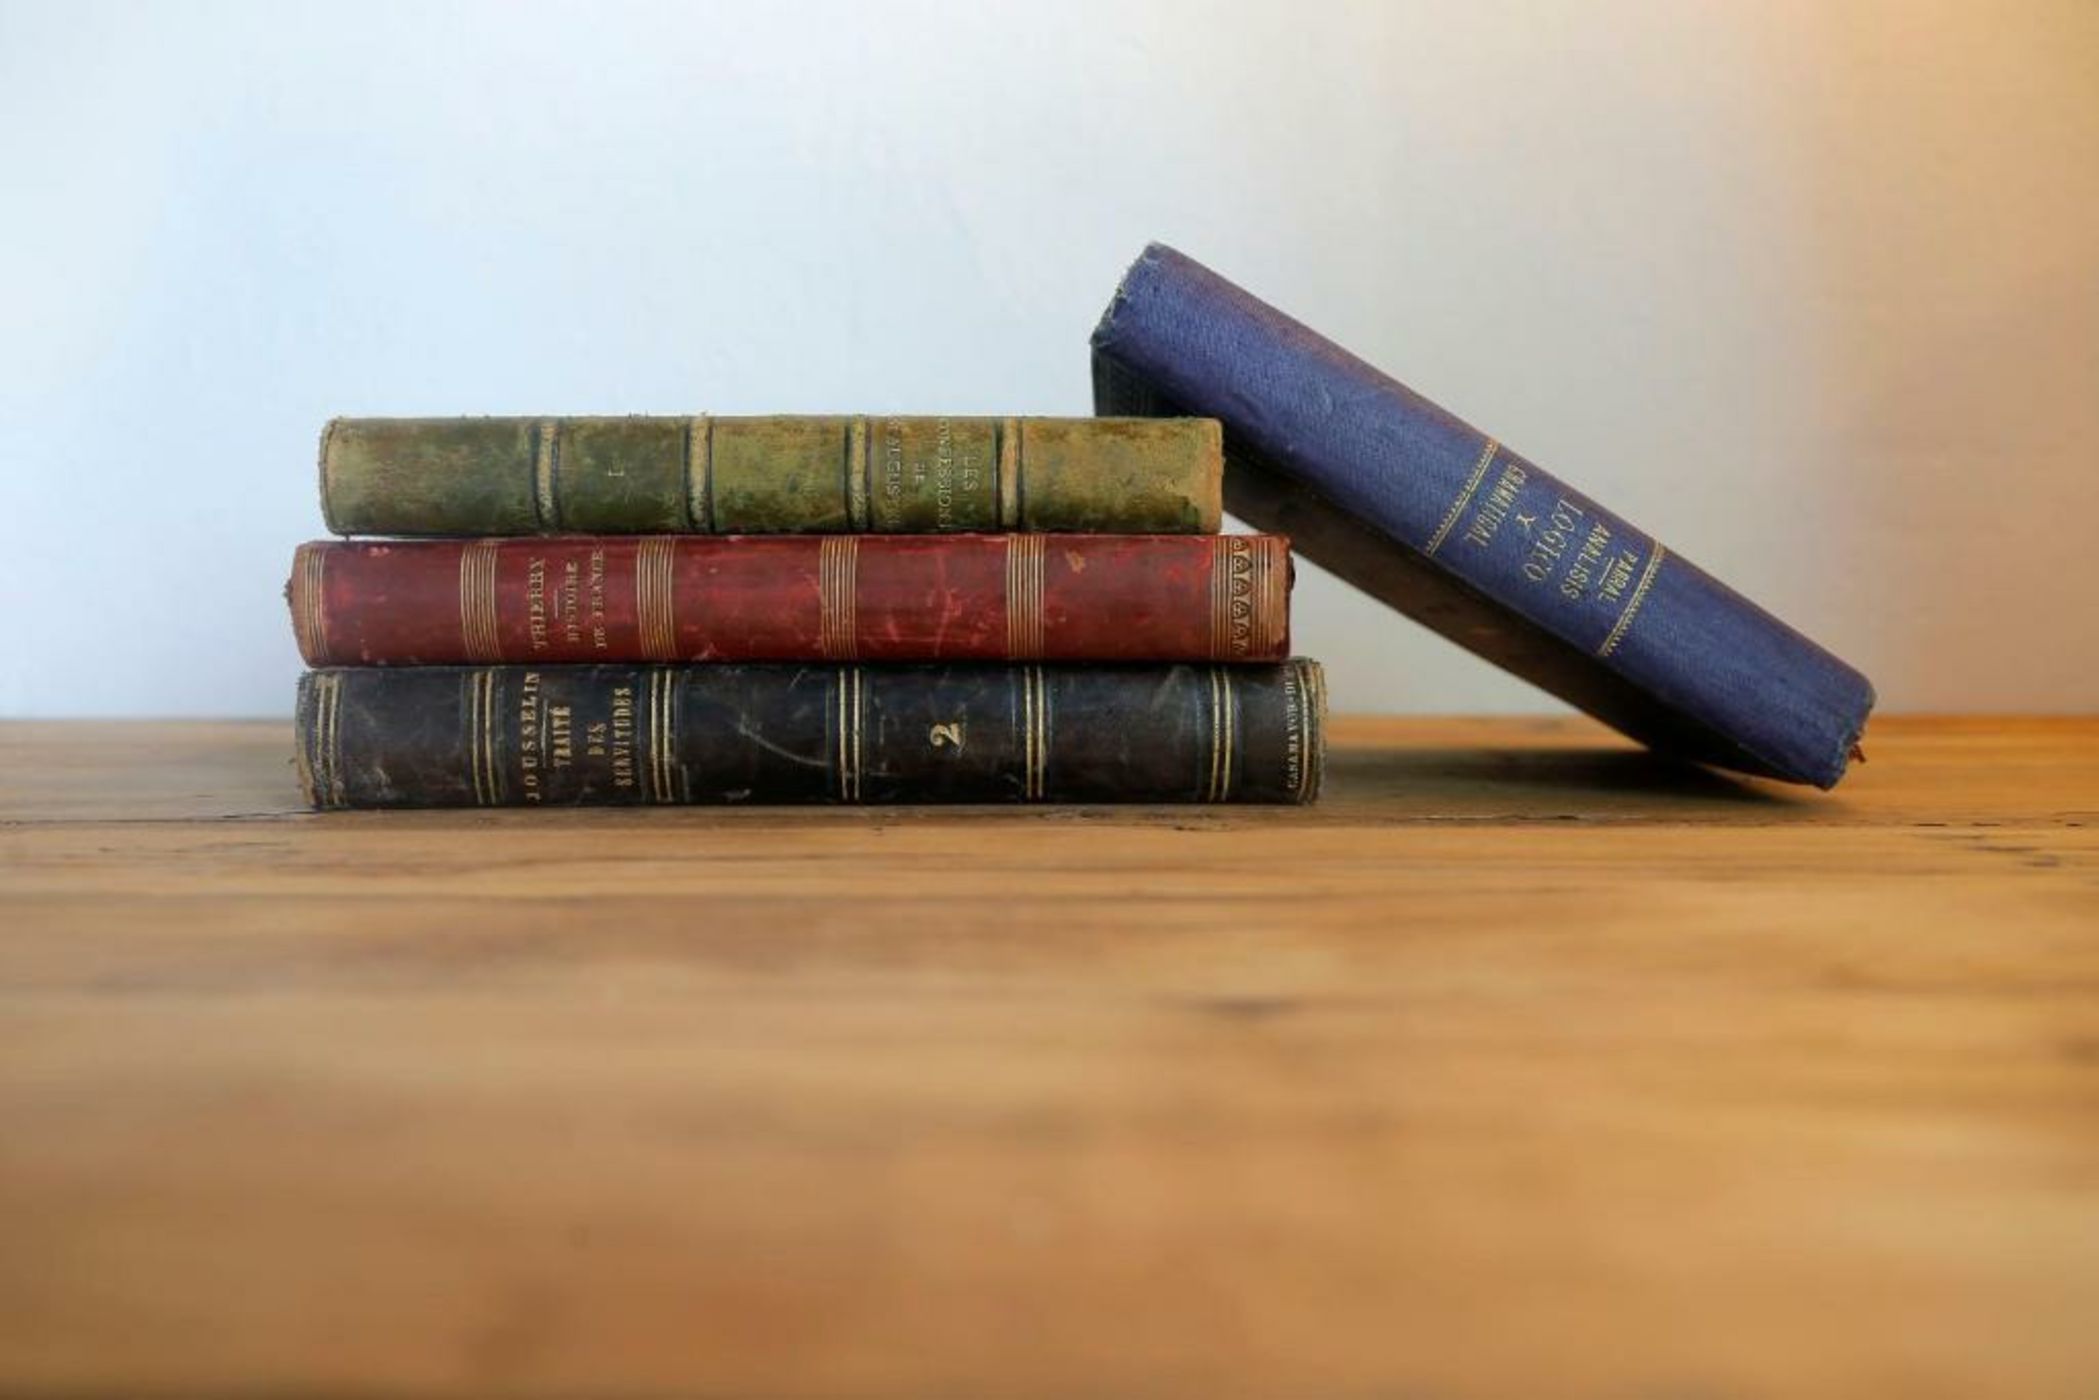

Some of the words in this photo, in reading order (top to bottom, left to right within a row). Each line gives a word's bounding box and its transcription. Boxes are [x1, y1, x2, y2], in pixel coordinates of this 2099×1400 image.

[962, 455, 980, 491] LES
[1463, 463, 1529, 548] GRAMATICAL
[1516, 513, 1537, 532] Y
[1522, 499, 1584, 583] LOGICO
[1560, 521, 1612, 600] ANALISIS
[529, 556, 547, 650] THIERRY
[565, 560, 581, 642] HISTOIRE
[521, 671, 541, 801] JOUSSELIN
[587, 722, 608, 755] DES
[612, 687, 633, 787] SERVITUDES
[929, 722, 960, 747] 2
